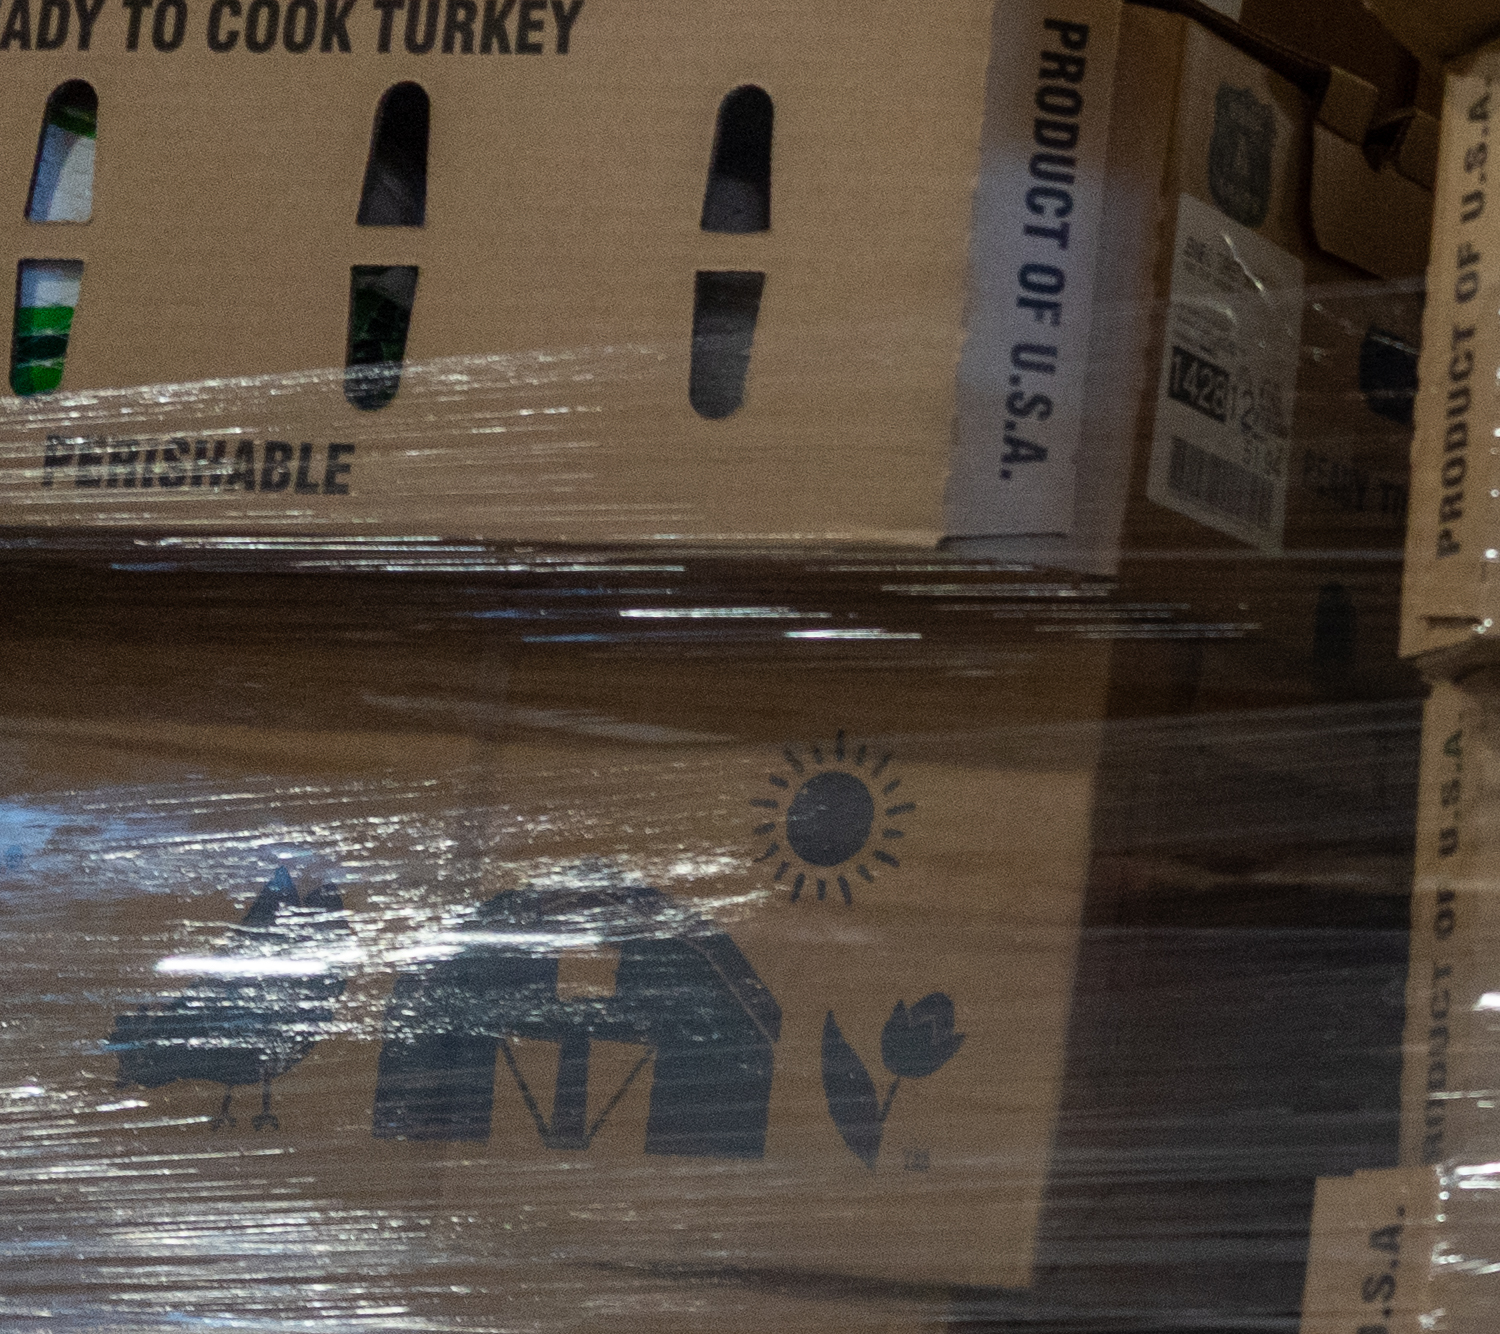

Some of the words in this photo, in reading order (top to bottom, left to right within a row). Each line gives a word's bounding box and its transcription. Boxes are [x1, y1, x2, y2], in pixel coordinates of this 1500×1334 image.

[1022, 15, 1091, 251] PRODUCT
[1017, 267, 1067, 327] OF
[1453, 240, 1482, 305] OF
[999, 340, 1062, 482] U.S.A.
[1435, 322, 1477, 561] PRODUCT
[40, 435, 355, 495] PERISHABLE
